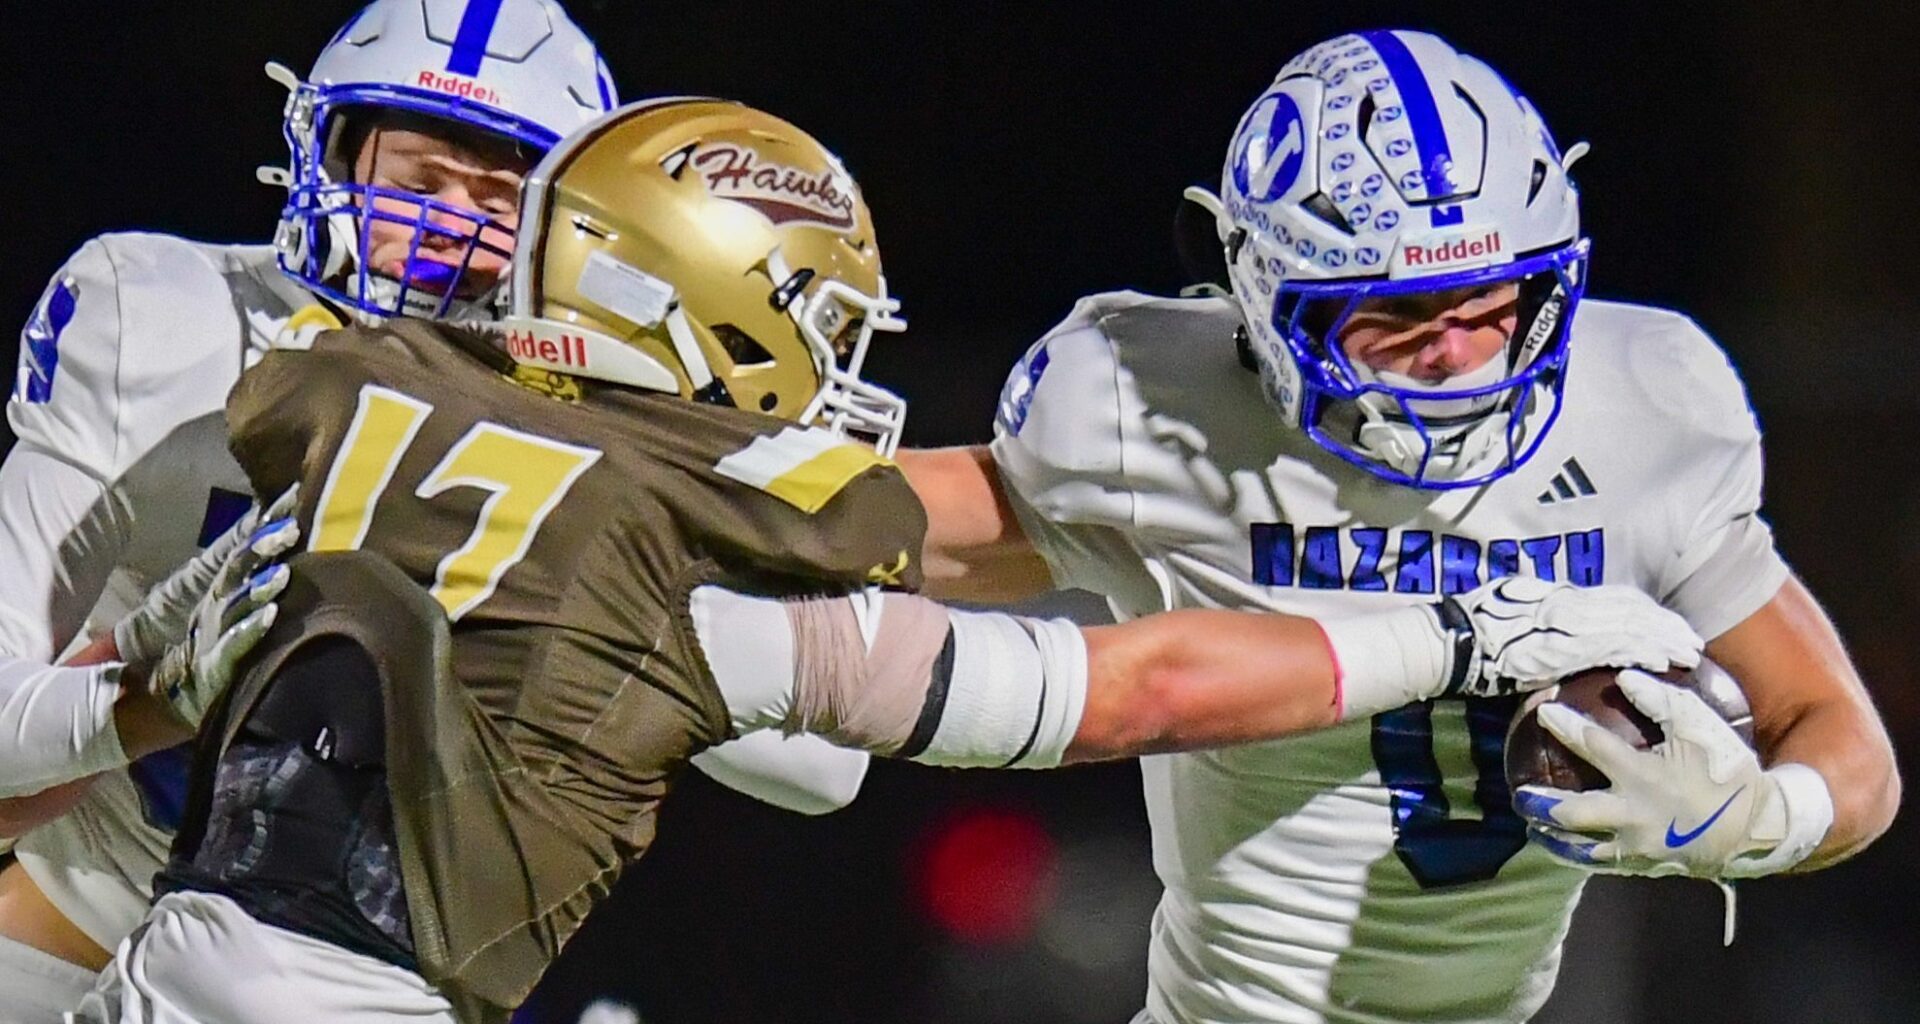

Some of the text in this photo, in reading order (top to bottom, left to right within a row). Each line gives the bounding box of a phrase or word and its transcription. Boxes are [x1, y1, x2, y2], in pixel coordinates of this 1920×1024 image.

[418, 71, 500, 104] Riddel
[695, 149, 854, 213] Hawks
[1404, 231, 1500, 266] Riddell
[510, 330, 587, 368] ddell
[1524, 300, 1561, 351] Ridd
[307, 383, 604, 624] 17
[1250, 522, 1605, 594] NAZARETH
